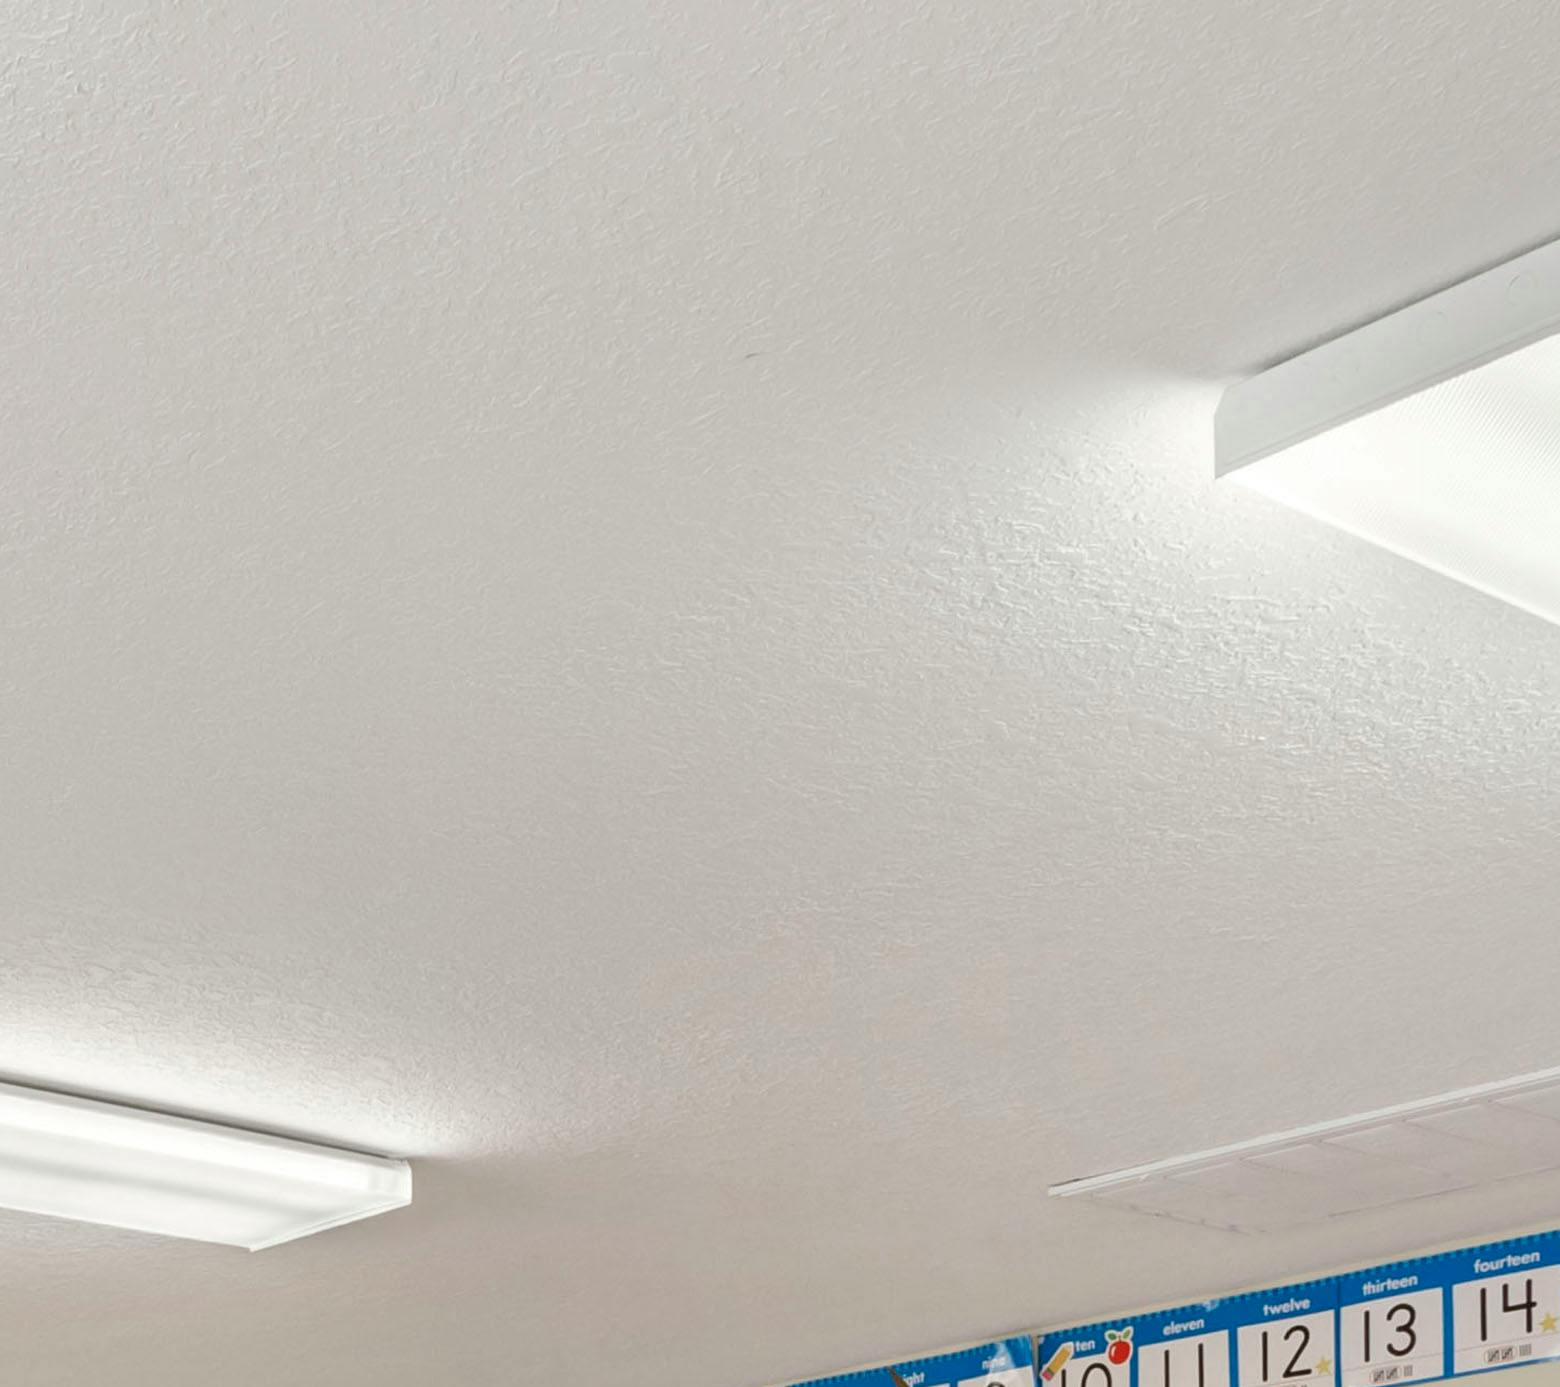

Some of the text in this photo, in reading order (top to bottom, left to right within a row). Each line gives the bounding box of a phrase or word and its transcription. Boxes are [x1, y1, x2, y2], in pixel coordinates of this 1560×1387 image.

[1472, 1248, 1542, 1274] fourteen
[1361, 1274, 1419, 1297] thirteen
[1261, 1296, 1312, 1317] twelve
[1479, 1277, 1538, 1343] 14
[1161, 1316, 1206, 1338] eleven
[1362, 1303, 1418, 1364] 13
[1074, 1338, 1096, 1354] ten
[1260, 1324, 1312, 1384] 12
[900, 1371, 925, 1387] ight
